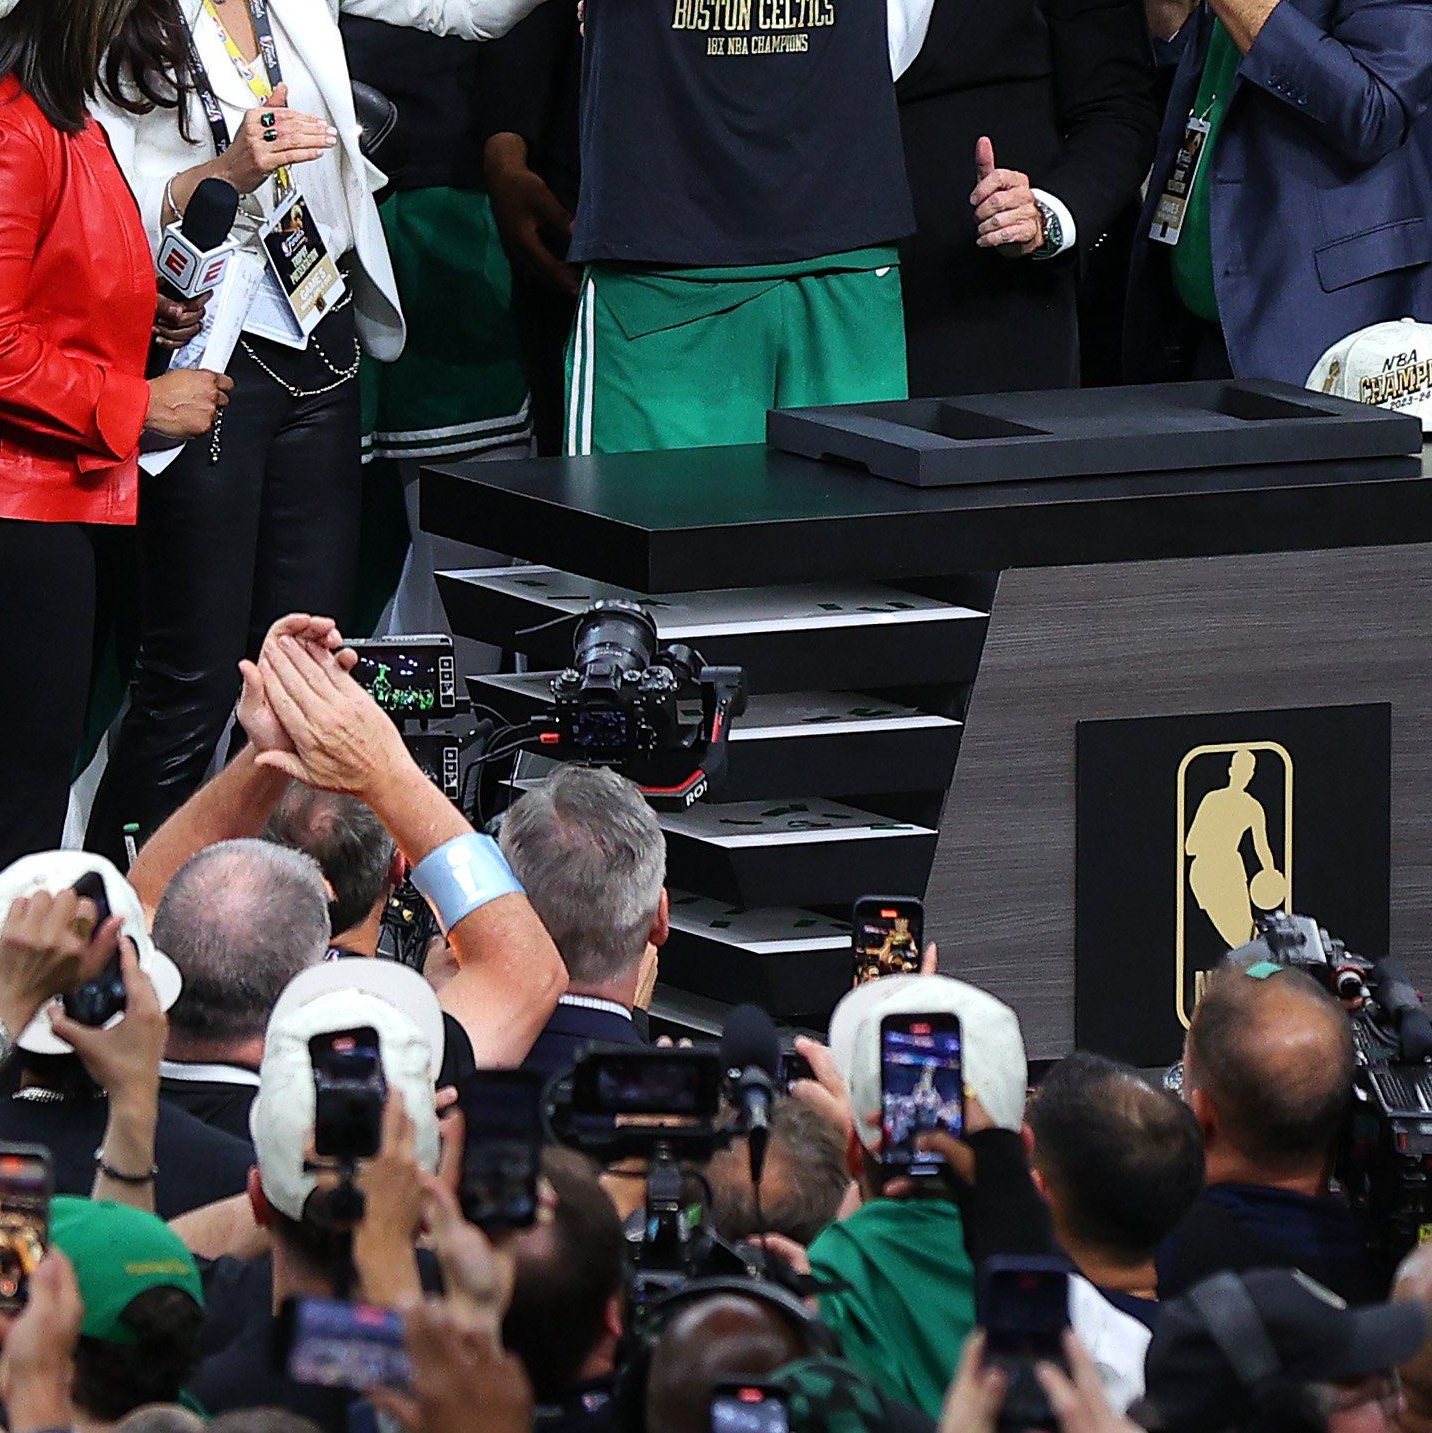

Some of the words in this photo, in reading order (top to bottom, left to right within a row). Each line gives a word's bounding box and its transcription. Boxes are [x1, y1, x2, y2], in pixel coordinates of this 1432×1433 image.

[707, 36, 725, 56] 18X
[727, 35, 749, 55] NBA
[751, 32, 808, 55] CHAMPIONS
[1382, 348, 1418, 372] NBA
[1388, 390, 1432, 410] 2023-24
